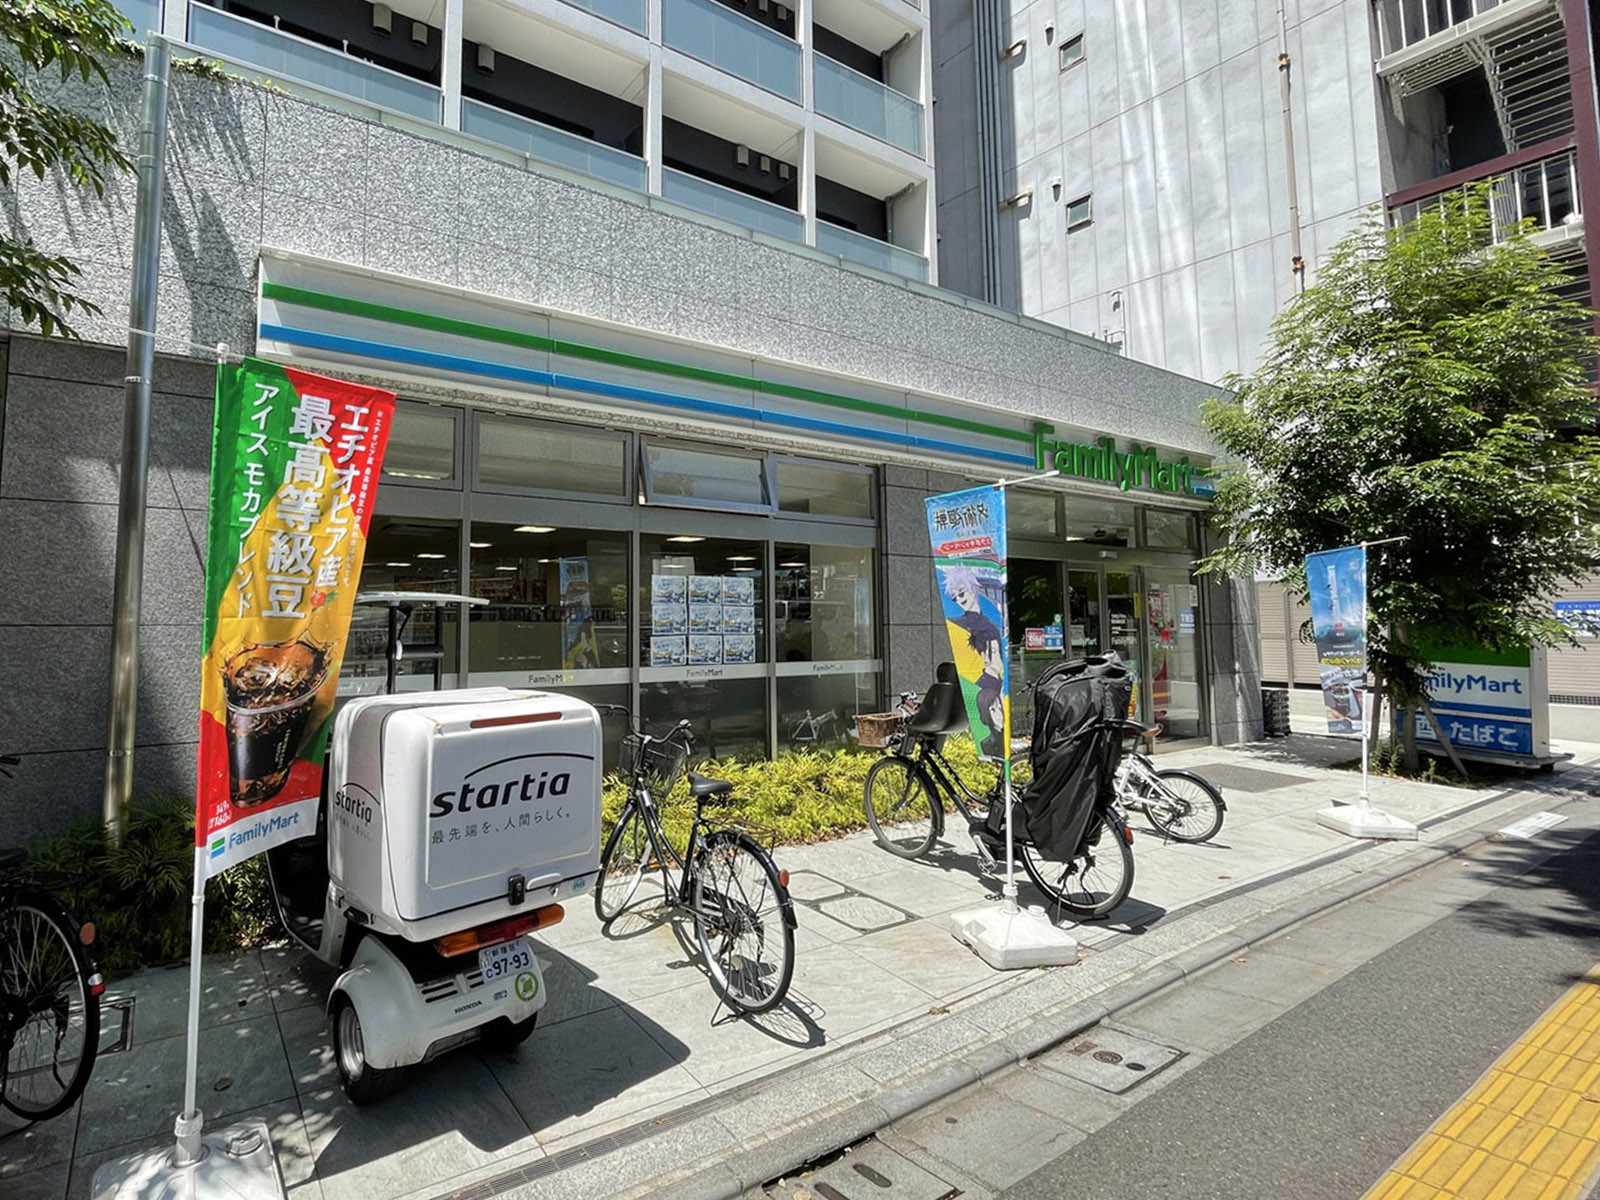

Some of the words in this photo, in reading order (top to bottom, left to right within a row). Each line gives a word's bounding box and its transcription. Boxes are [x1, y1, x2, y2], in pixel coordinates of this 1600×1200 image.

[1033, 420, 1196, 494] FamilyMart
[261, 393, 336, 619] 最高等級豆
[314, 404, 370, 587] エチオピア産
[1450, 721, 1518, 747] たばこ
[335, 791, 372, 824] startia
[429, 771, 571, 818] startia
[228, 811, 300, 850] FamilyMart
[431, 807, 570, 845] 最先端を、人間らしく。
[454, 1000, 482, 1014] HONDA
